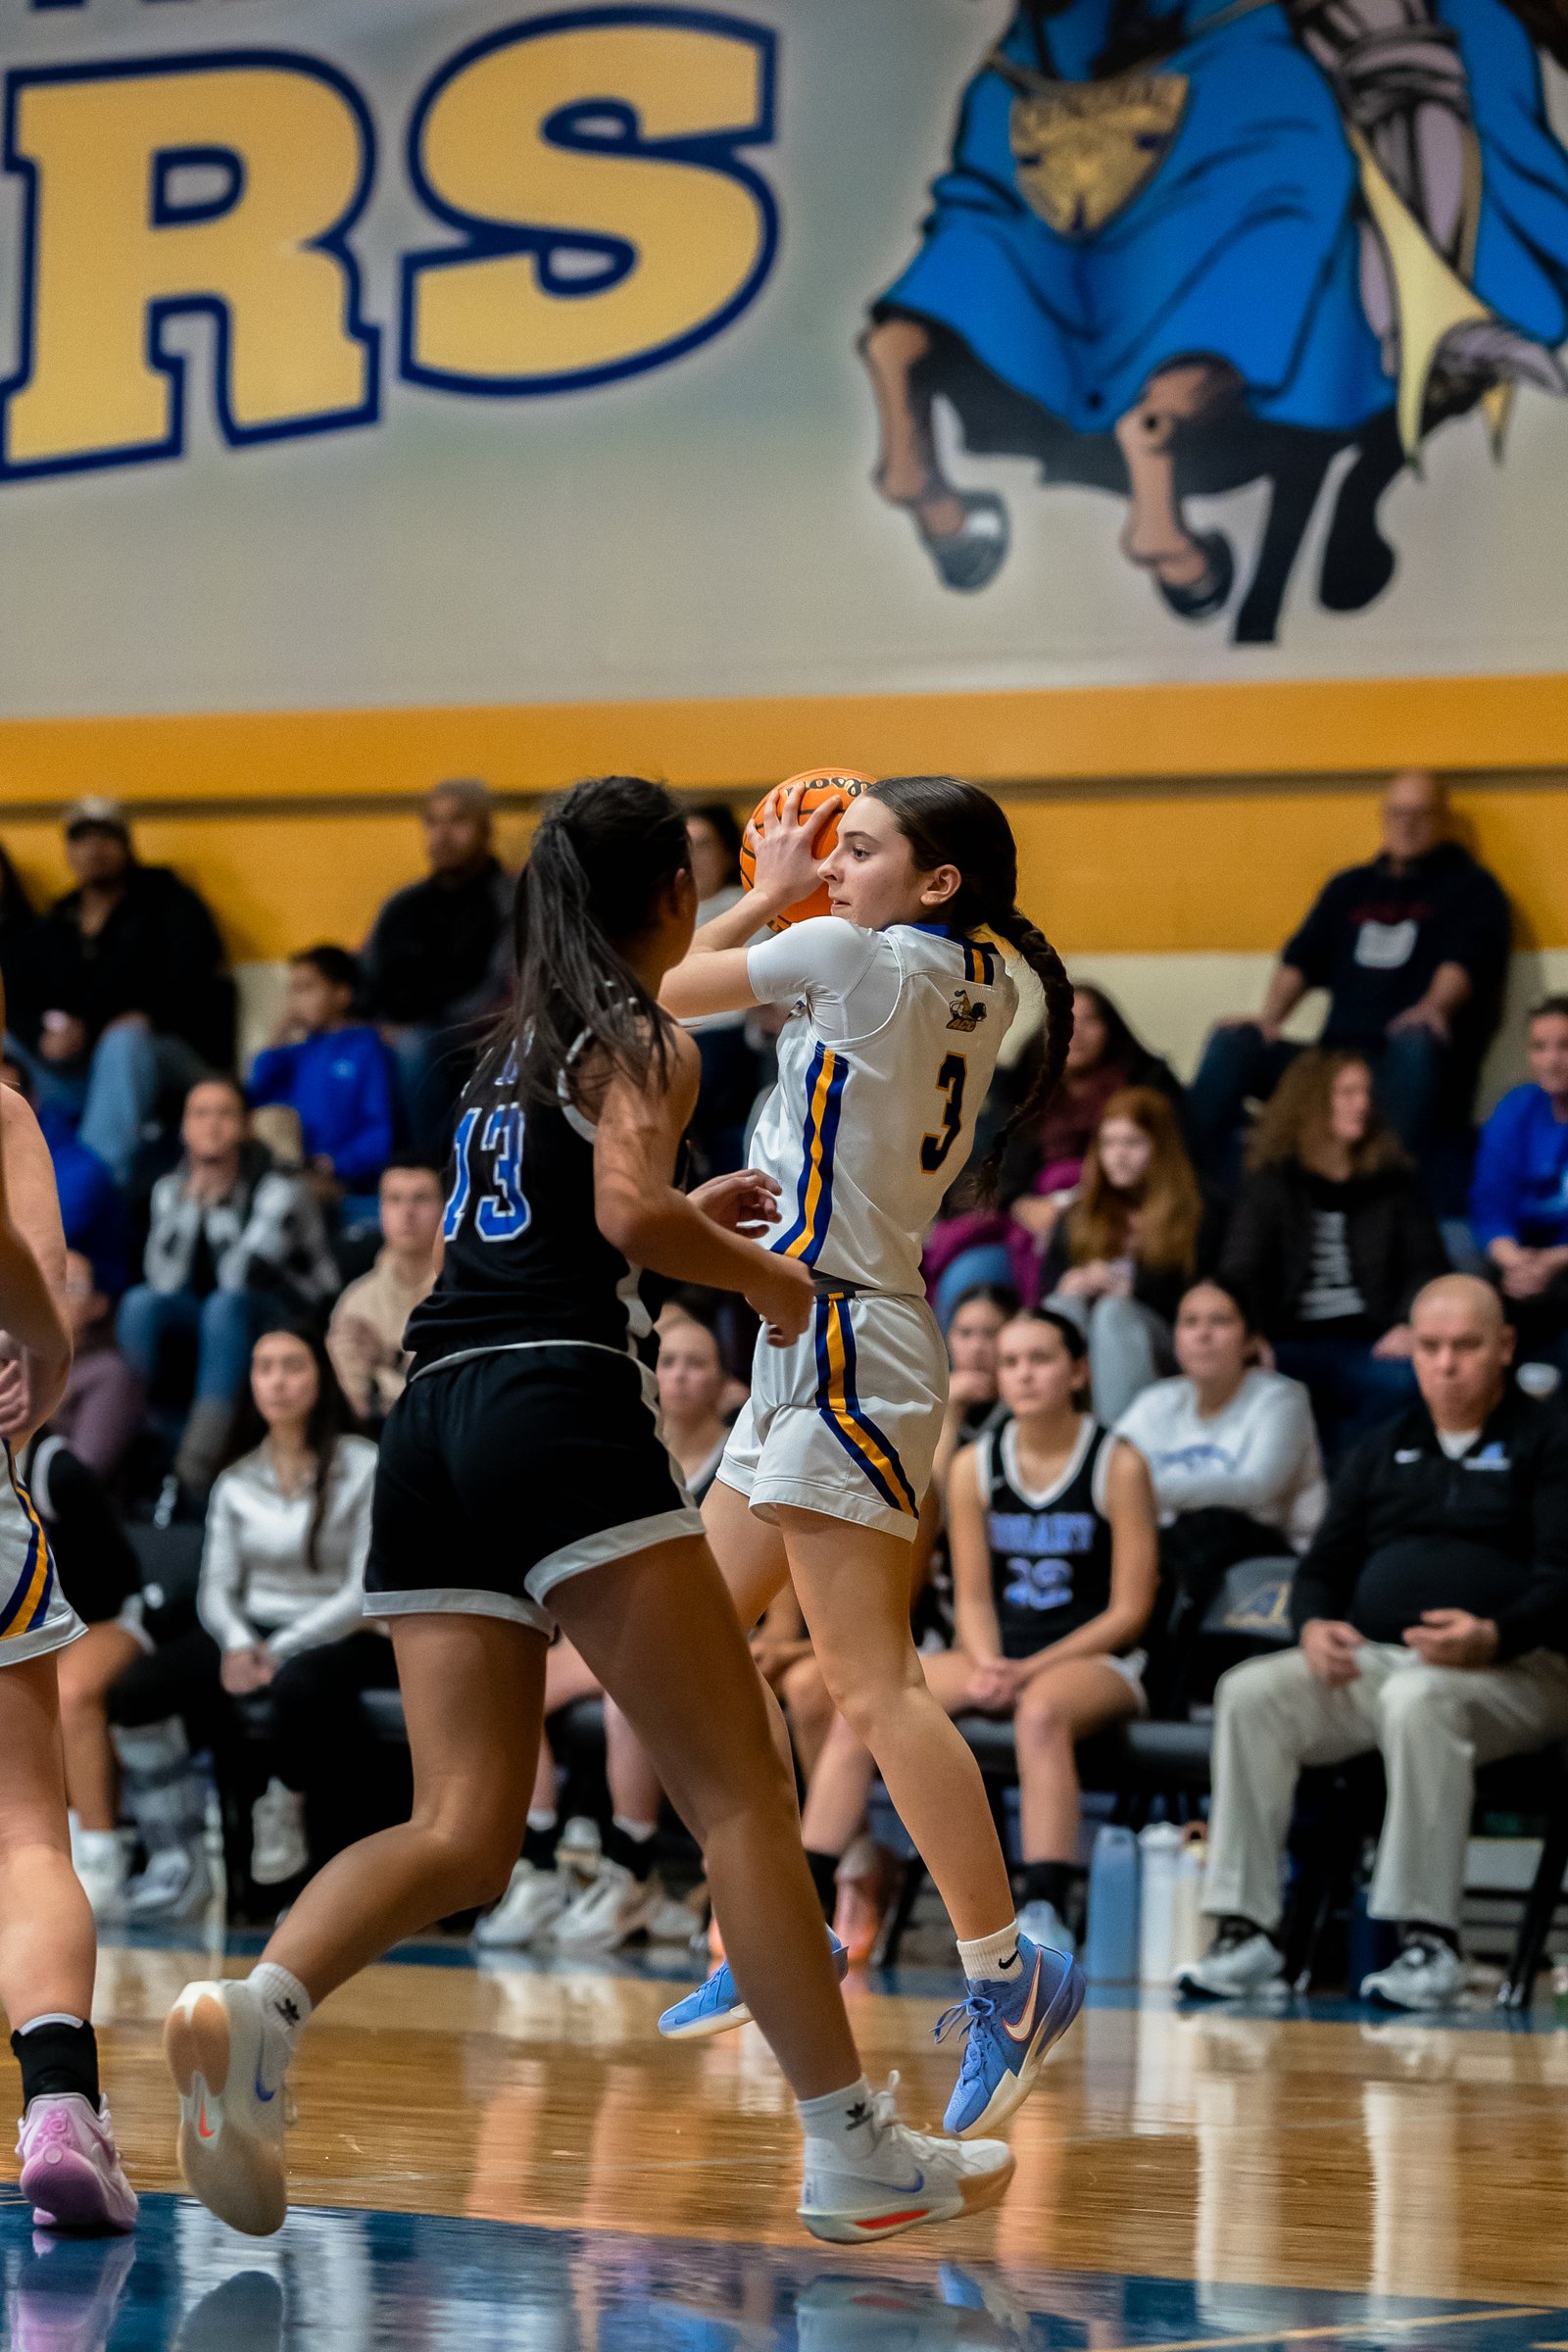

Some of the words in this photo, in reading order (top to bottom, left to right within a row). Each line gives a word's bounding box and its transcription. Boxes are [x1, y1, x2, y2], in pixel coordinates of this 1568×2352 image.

[0, 4, 780, 482] RS
[443, 1102, 531, 1243] 13
[918, 1050, 967, 1174] 3
